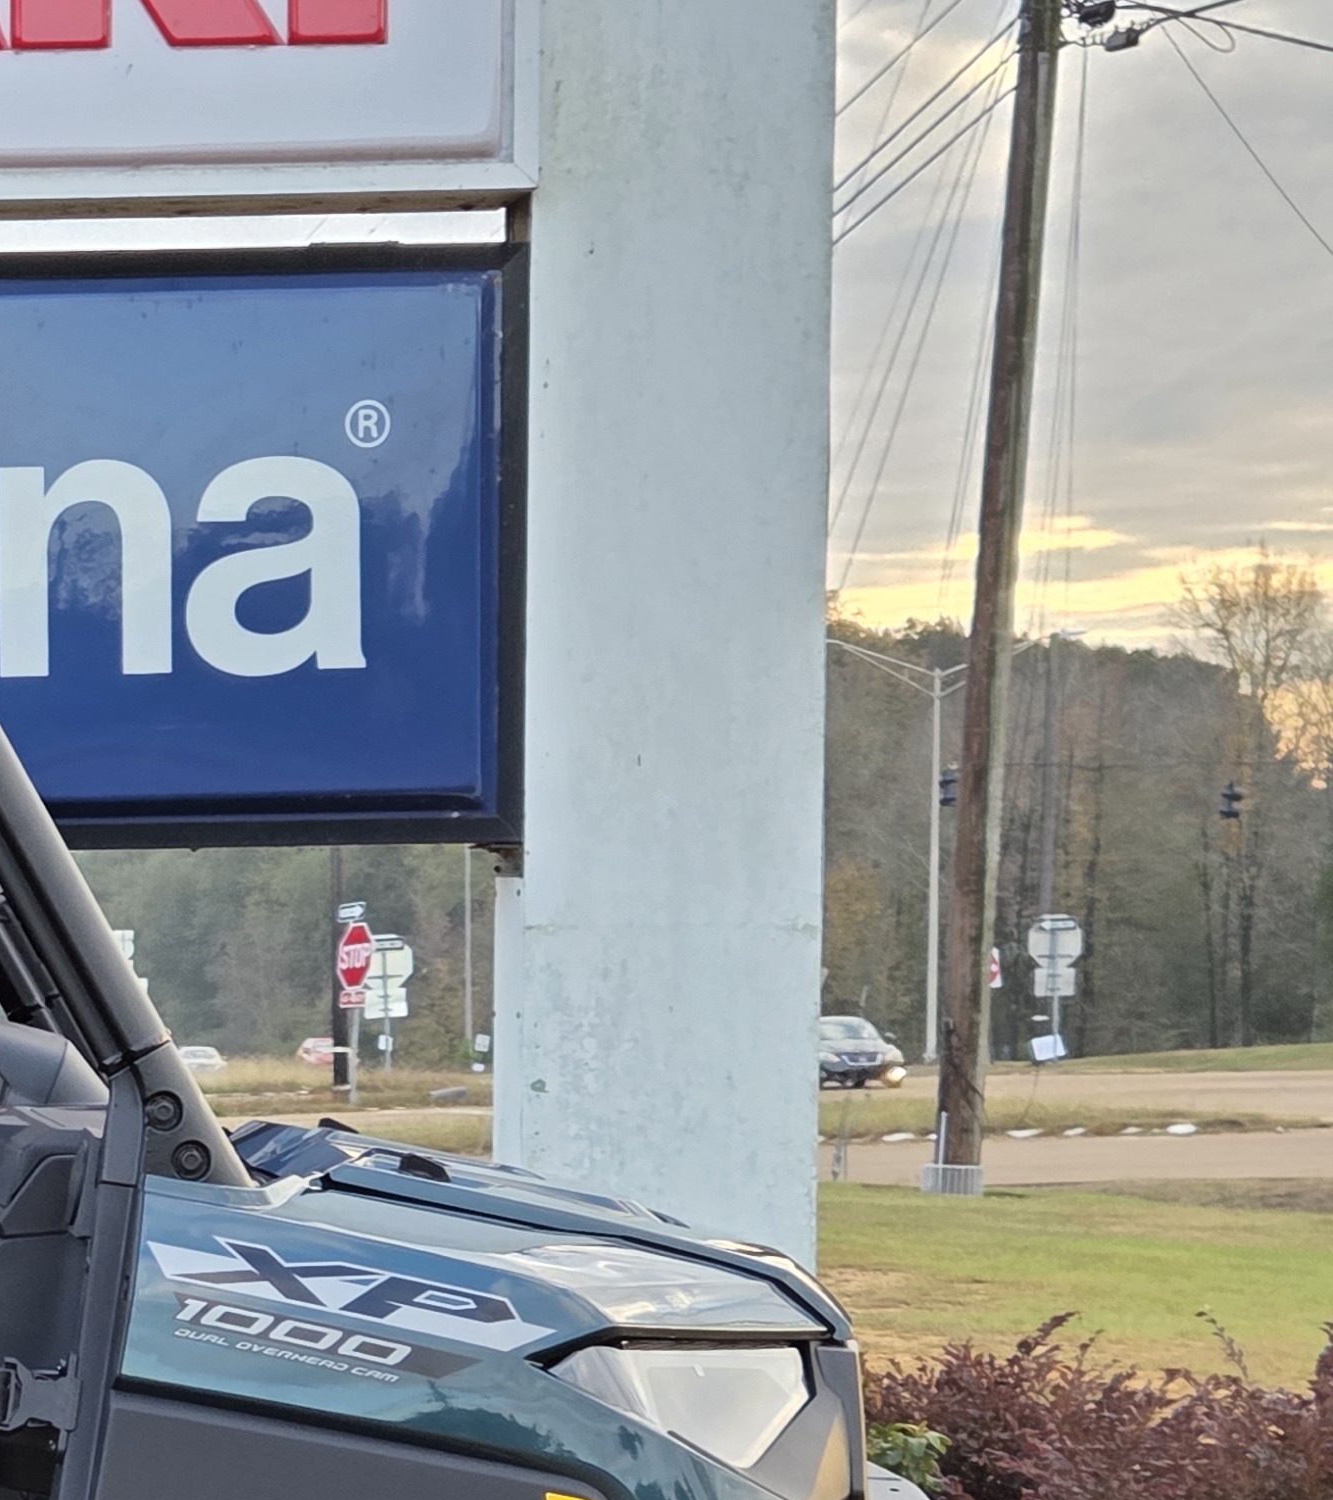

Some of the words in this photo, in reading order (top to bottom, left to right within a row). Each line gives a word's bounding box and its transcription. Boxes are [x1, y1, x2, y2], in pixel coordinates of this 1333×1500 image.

[340, 942, 372, 969] STOP
[169, 1236, 517, 1324] XP
[173, 1327, 230, 1347] DUAL
[235, 1341, 350, 1373] OVERHEAD
[350, 1366, 401, 1384] CAM
[175, 1298, 413, 1366] 1000
